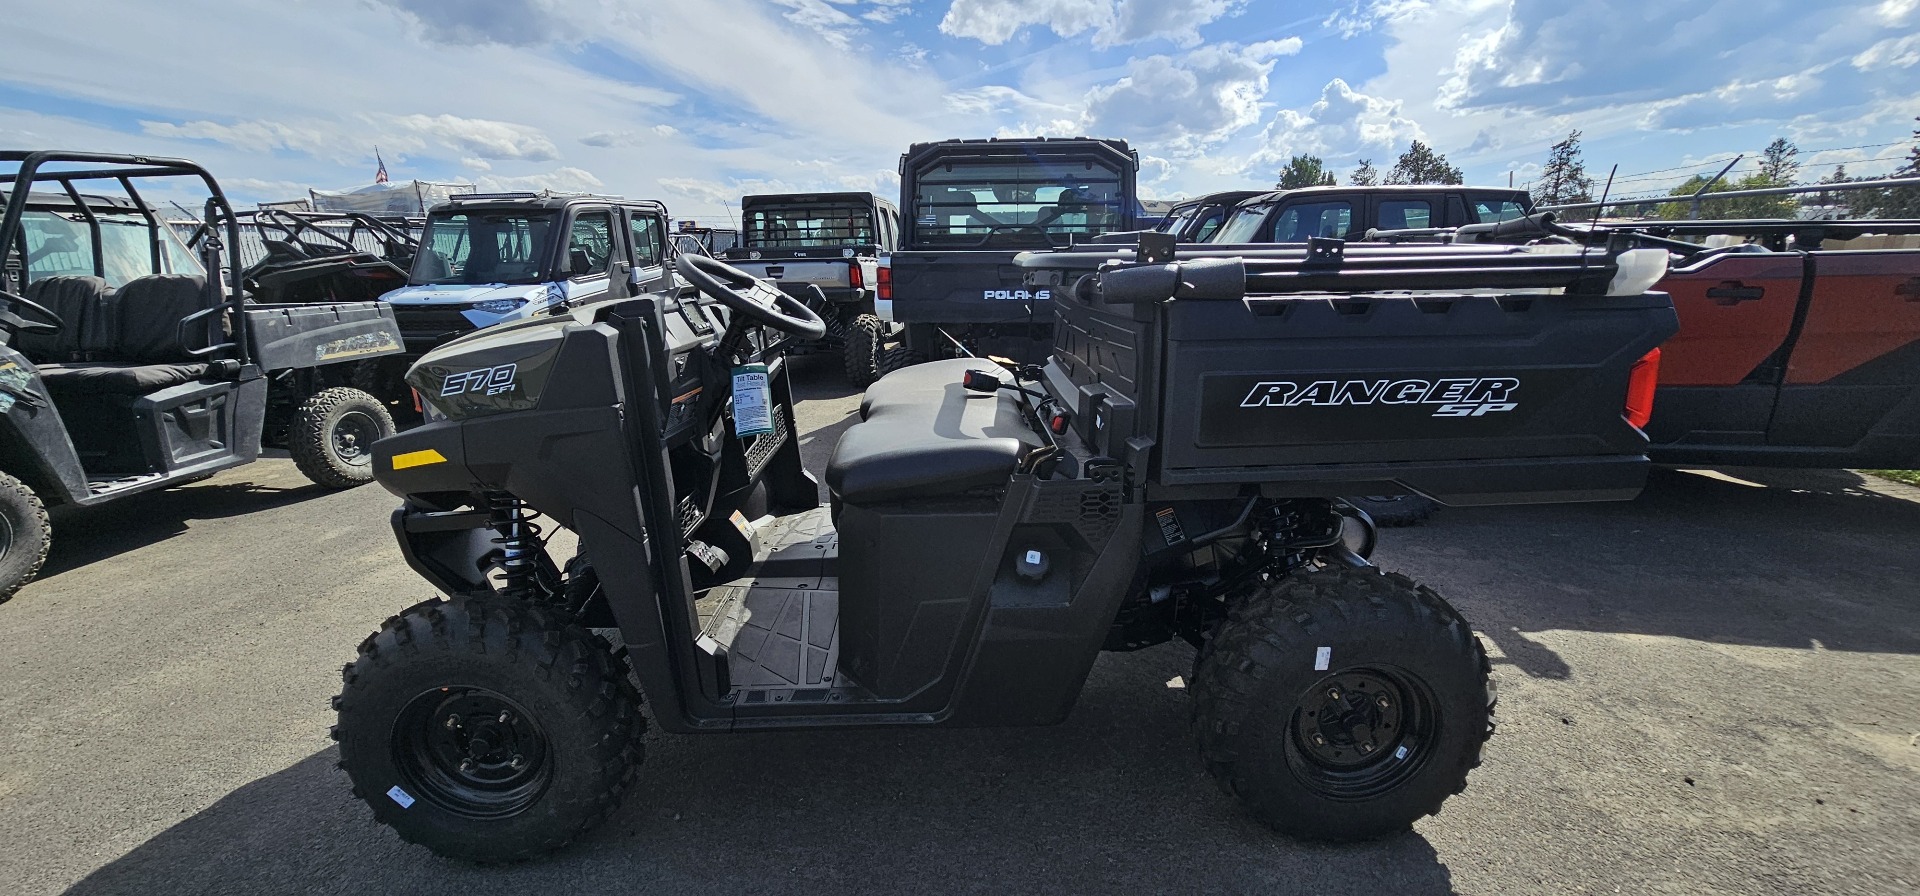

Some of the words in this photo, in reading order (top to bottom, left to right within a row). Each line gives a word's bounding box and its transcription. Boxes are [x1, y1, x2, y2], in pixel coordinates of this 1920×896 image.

[440, 363, 517, 396] 570
[486, 384, 515, 396] EFI
[1239, 377, 1520, 408] RANGER
[1431, 402, 1518, 417] SP
